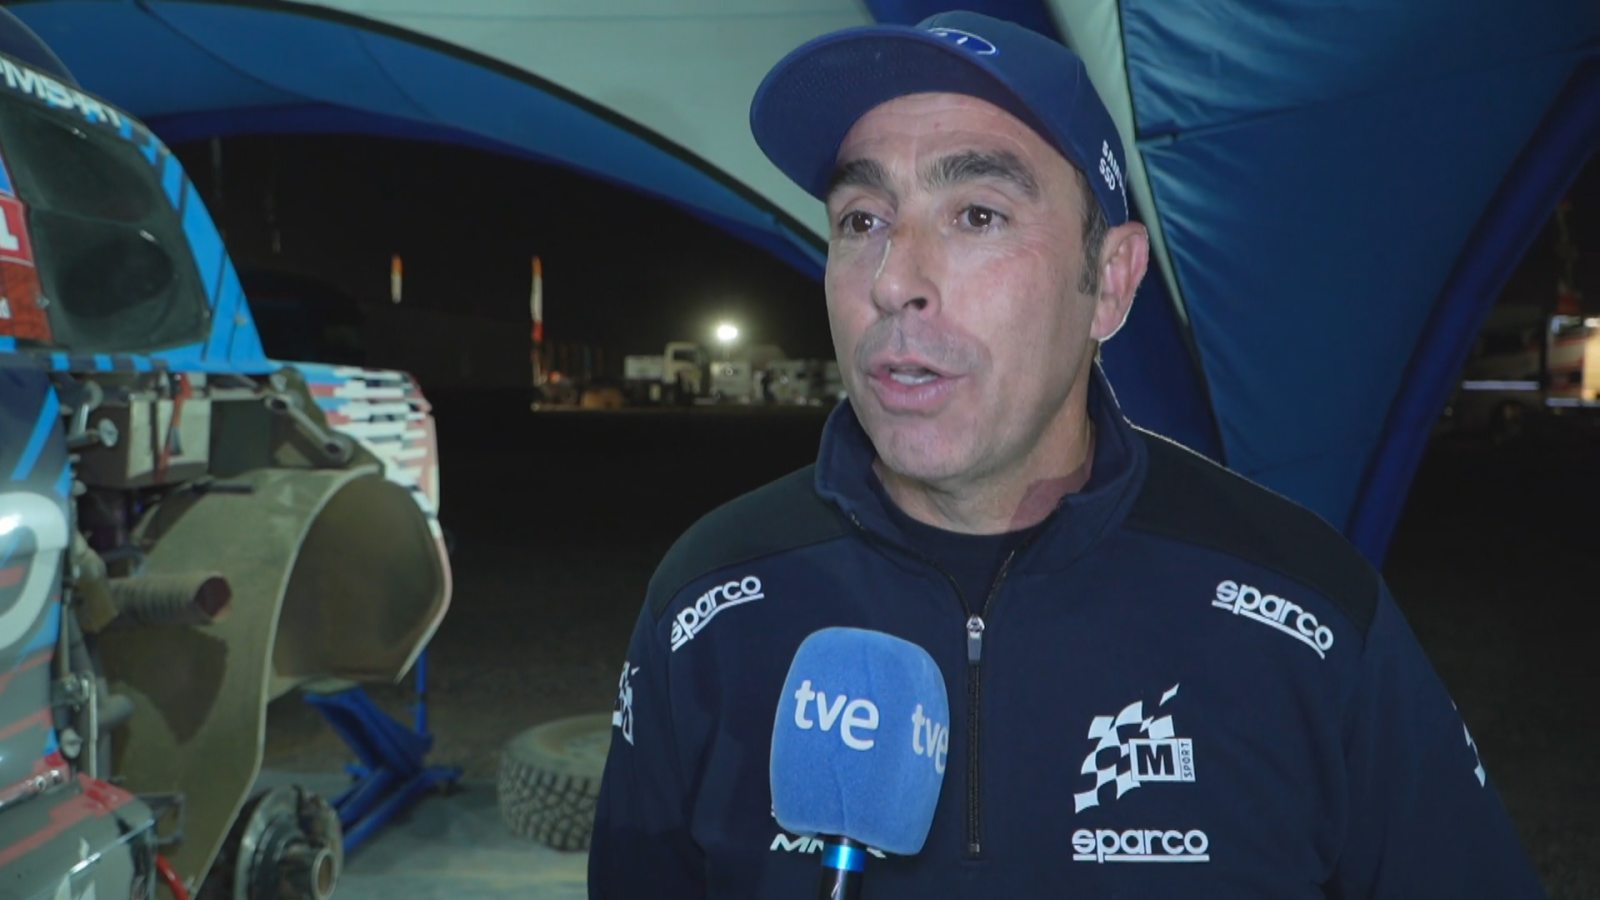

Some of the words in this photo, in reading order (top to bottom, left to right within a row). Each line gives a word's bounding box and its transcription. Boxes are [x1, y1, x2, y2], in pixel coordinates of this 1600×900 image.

[1099, 157, 1116, 191] SSD
[670, 575, 763, 646] sparco
[1215, 579, 1334, 652] sparco
[794, 679, 880, 751] tve
[911, 704, 948, 775] tve
[1136, 743, 1175, 777] M
[1181, 742, 1193, 778] SPORT
[1072, 827, 1209, 864] sparco
